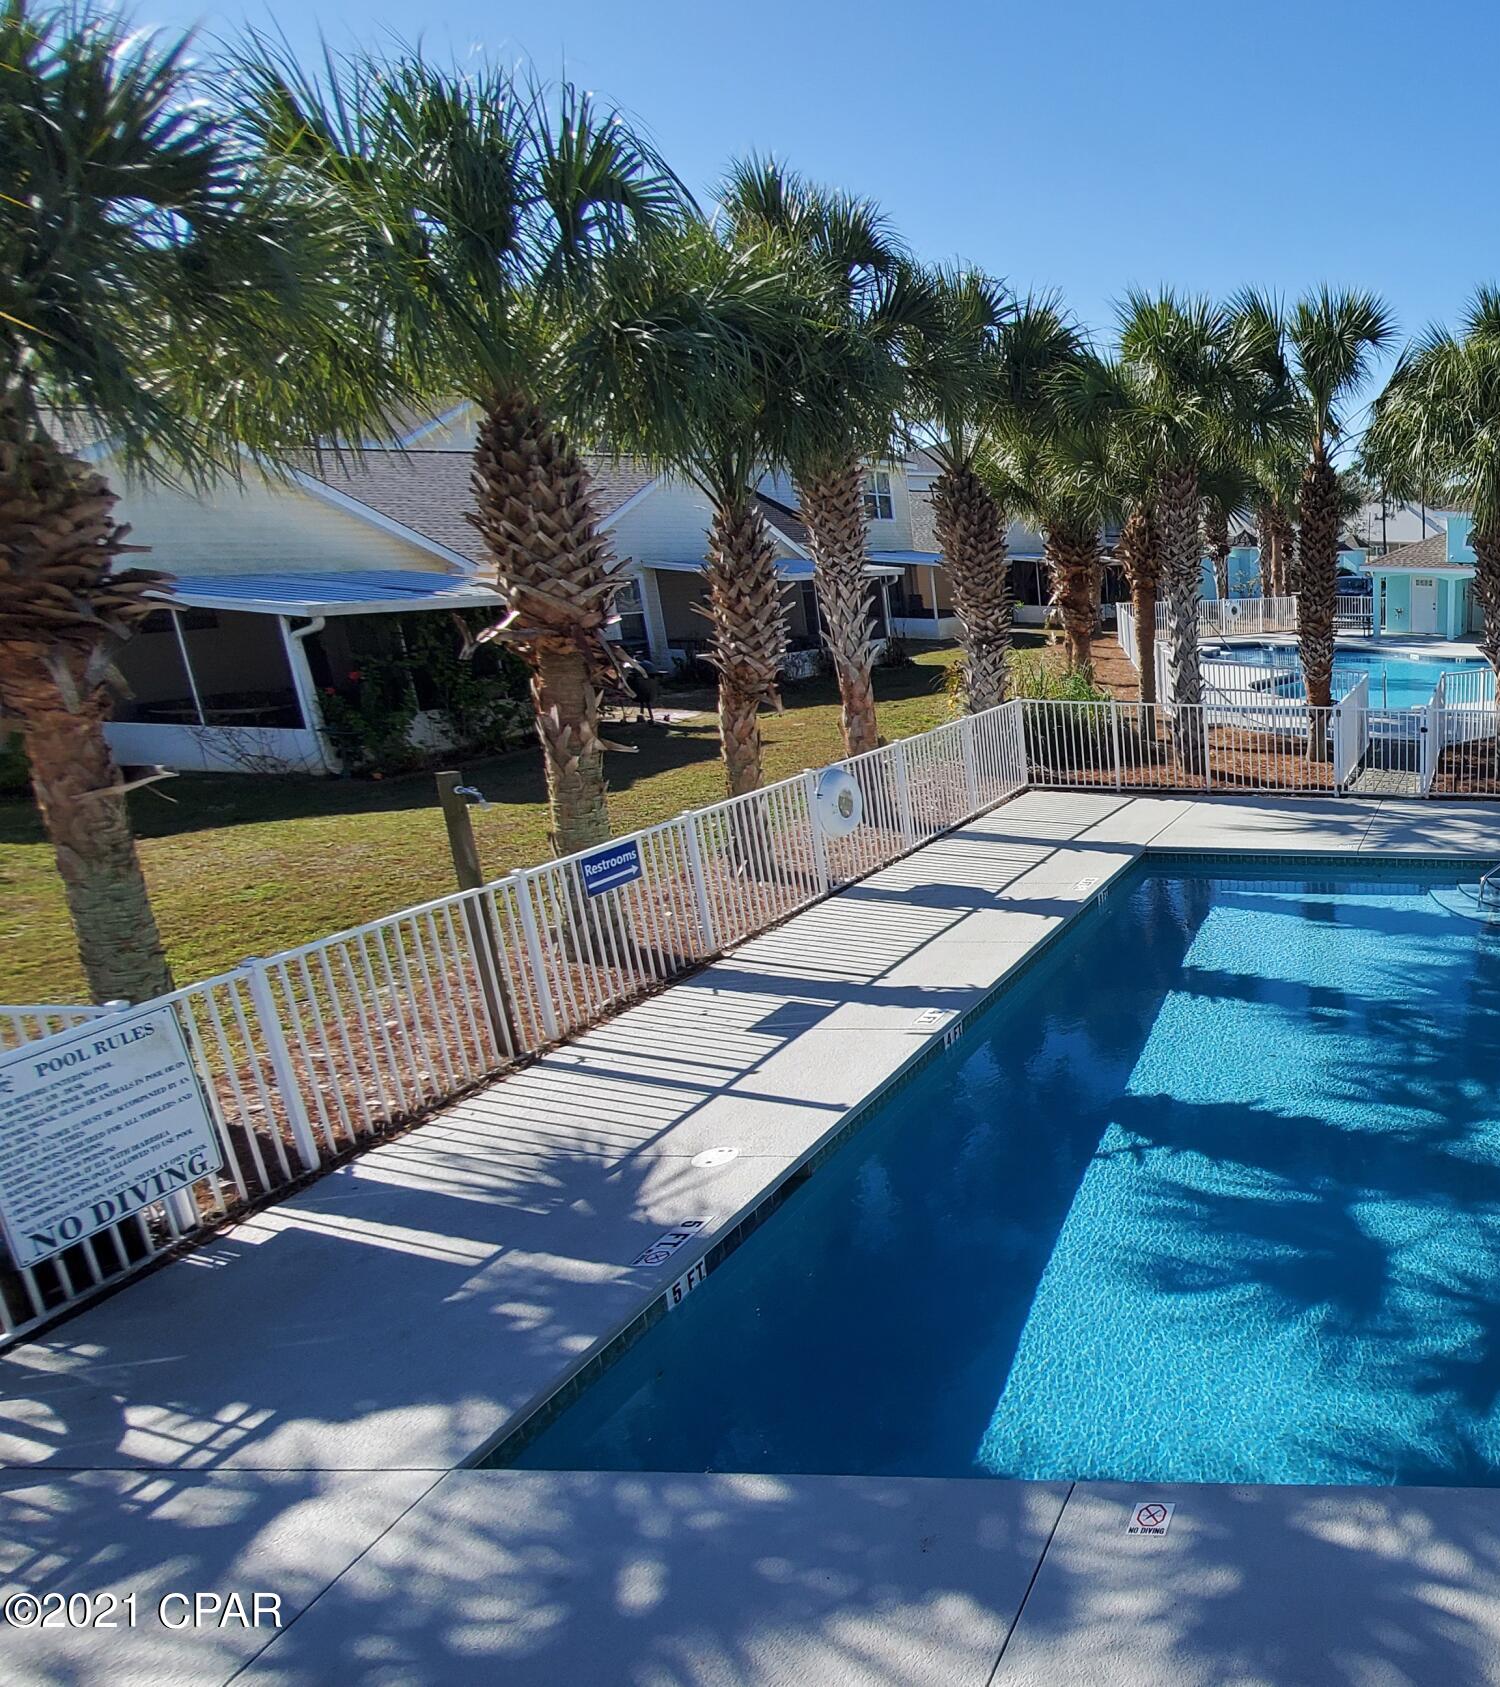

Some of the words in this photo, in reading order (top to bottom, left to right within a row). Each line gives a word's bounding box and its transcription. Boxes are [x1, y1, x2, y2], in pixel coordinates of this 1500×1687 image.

[584, 850, 637, 877] Restrooms
[33, 1045, 90, 1078] POOL
[91, 1021, 155, 1056] RULES
[27, 1215, 84, 1257] NO
[672, 1281, 682, 1304] 5
